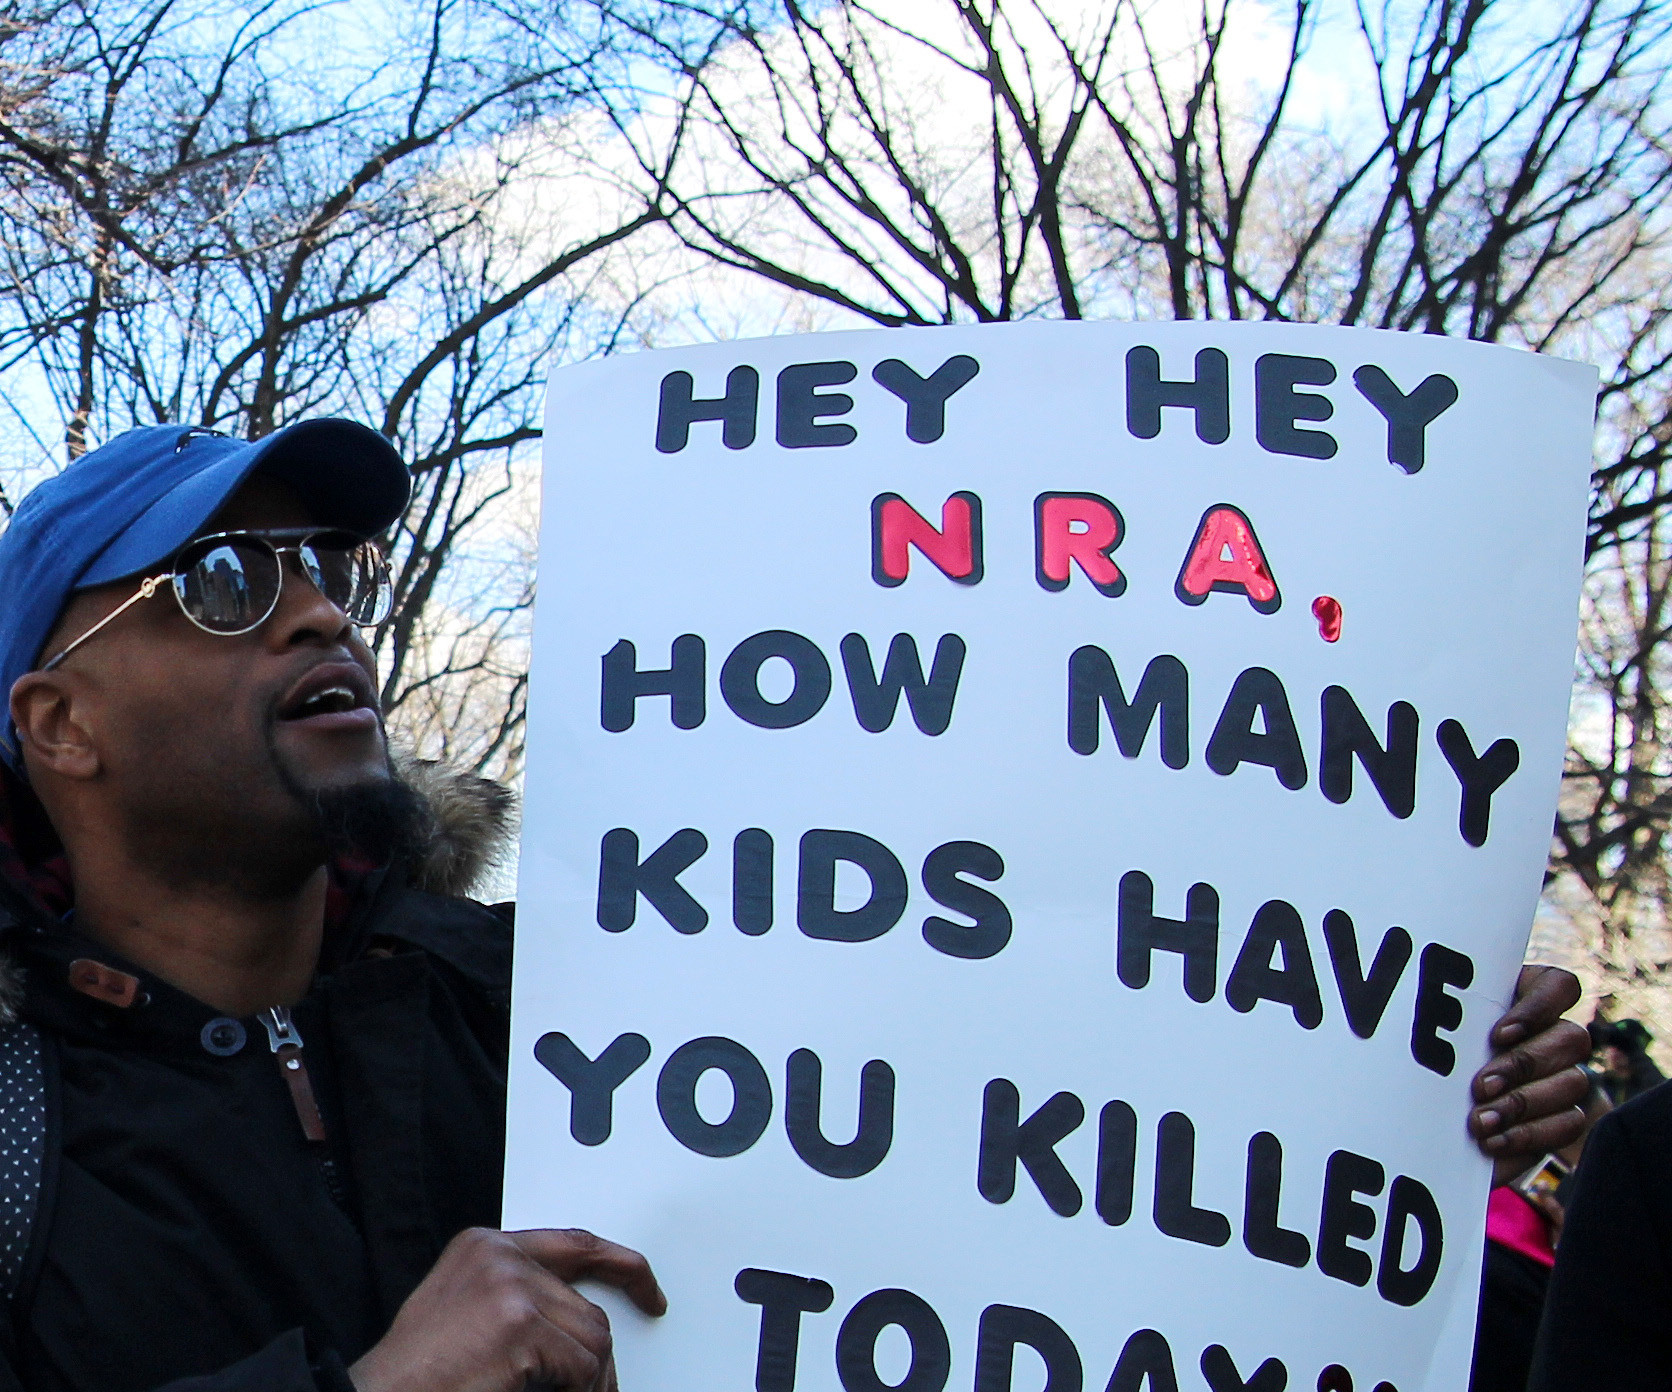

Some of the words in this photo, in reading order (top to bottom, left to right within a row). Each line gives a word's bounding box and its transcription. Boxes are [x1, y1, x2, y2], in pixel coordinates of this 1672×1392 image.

[655, 354, 980, 454] HEY
[1125, 344, 1459, 475] HEY
[600, 629, 967, 737] HOW
[1067, 644, 1521, 848] MANY
[596, 827, 1013, 960] KIDS
[1116, 869, 1475, 1078] HAVE
[533, 1031, 896, 1180] YOU
[977, 1077, 1444, 1307] KILLED
